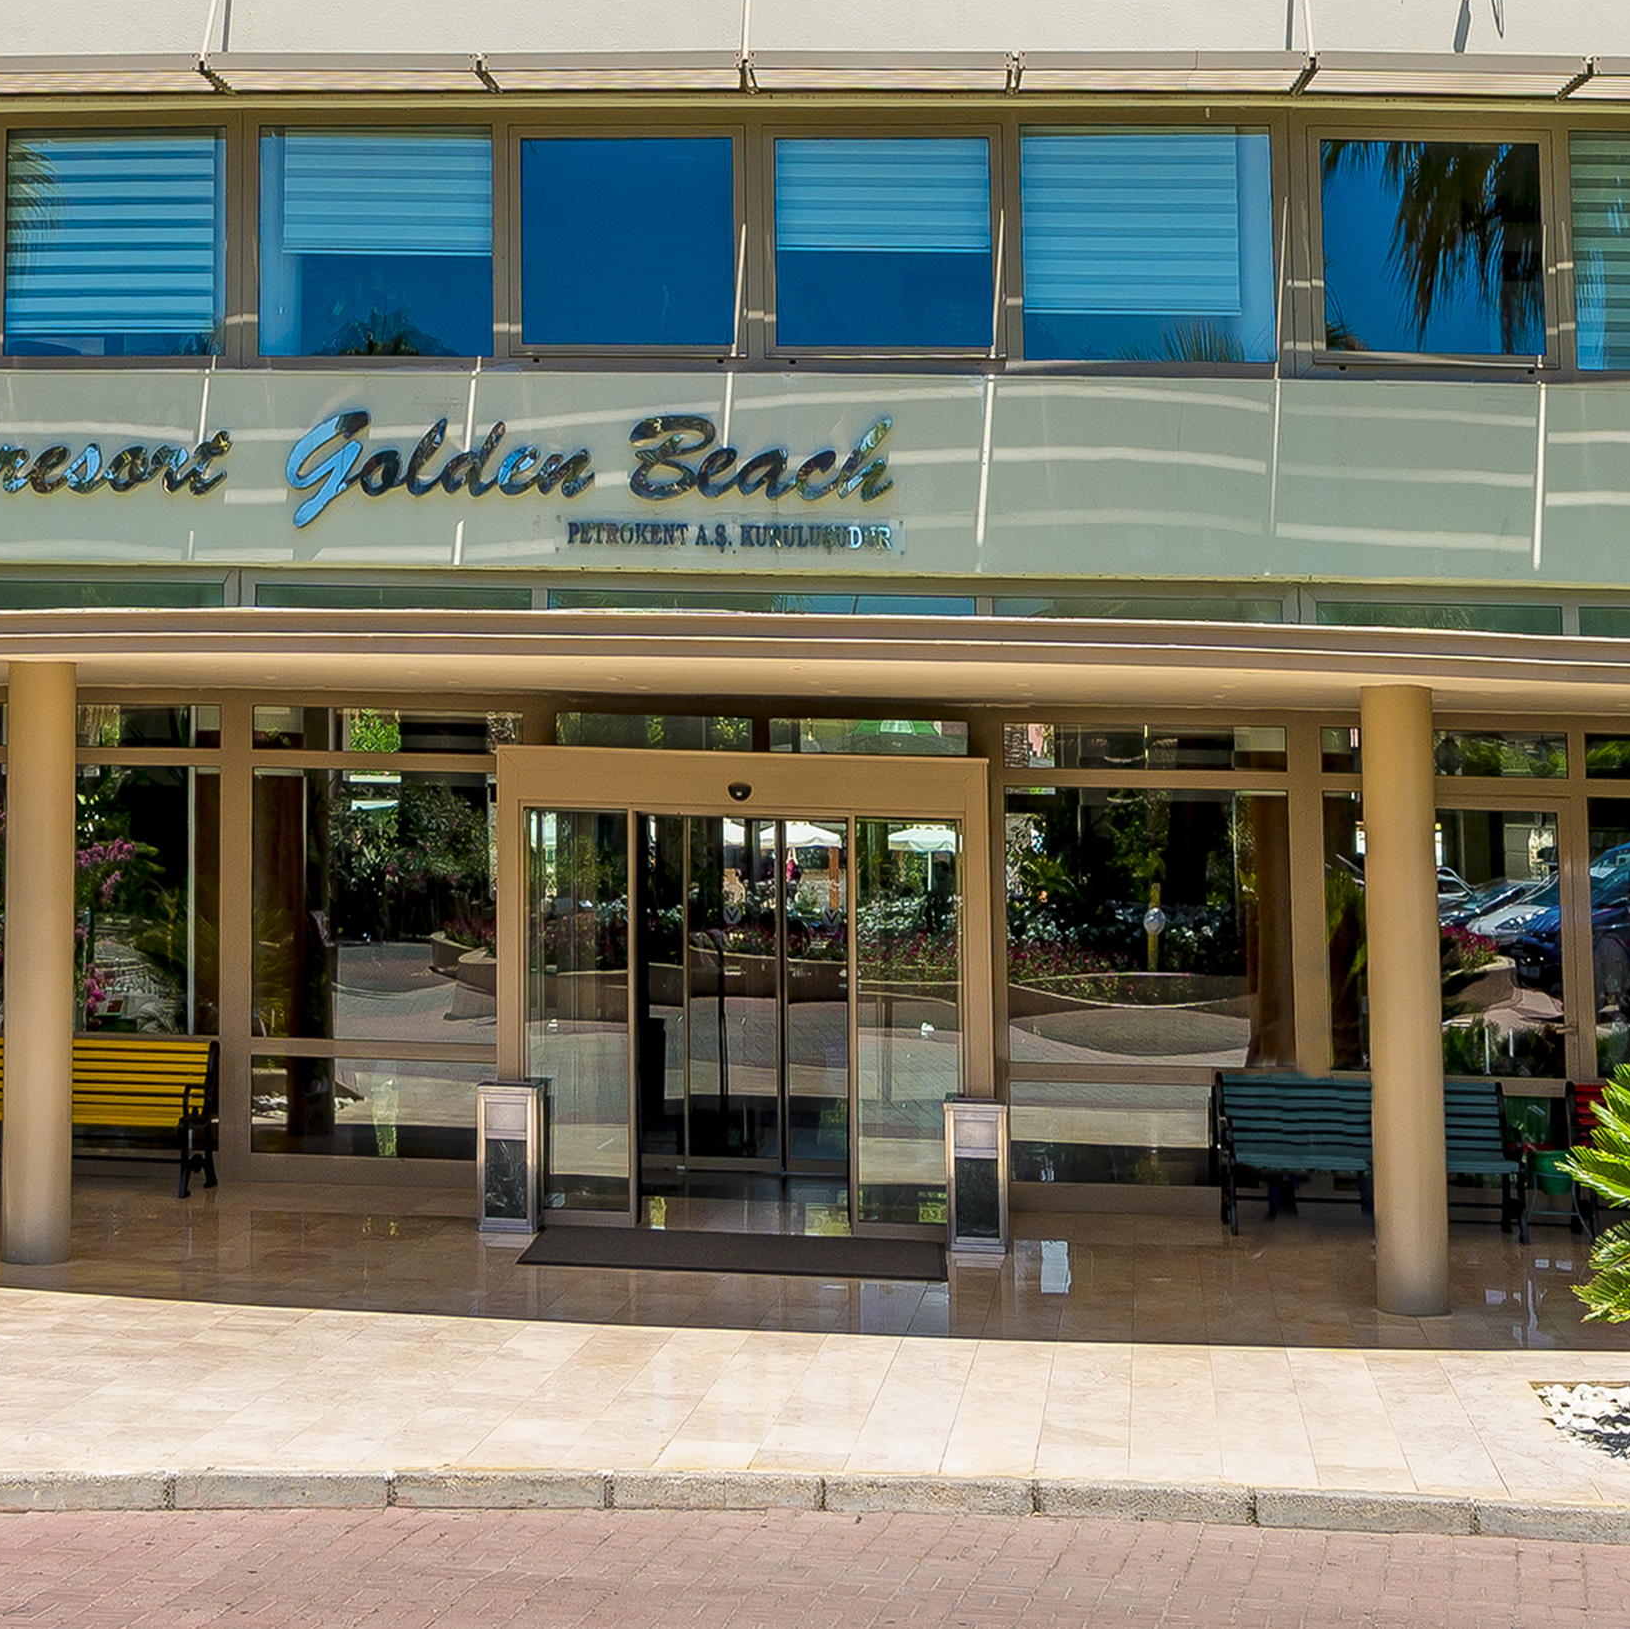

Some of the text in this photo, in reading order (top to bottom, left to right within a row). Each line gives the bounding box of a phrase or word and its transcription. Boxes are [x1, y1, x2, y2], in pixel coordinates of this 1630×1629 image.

[285, 409, 597, 529] Golden
[629, 414, 894, 502] Beach
[567, 521, 689, 546] PETROKENT
